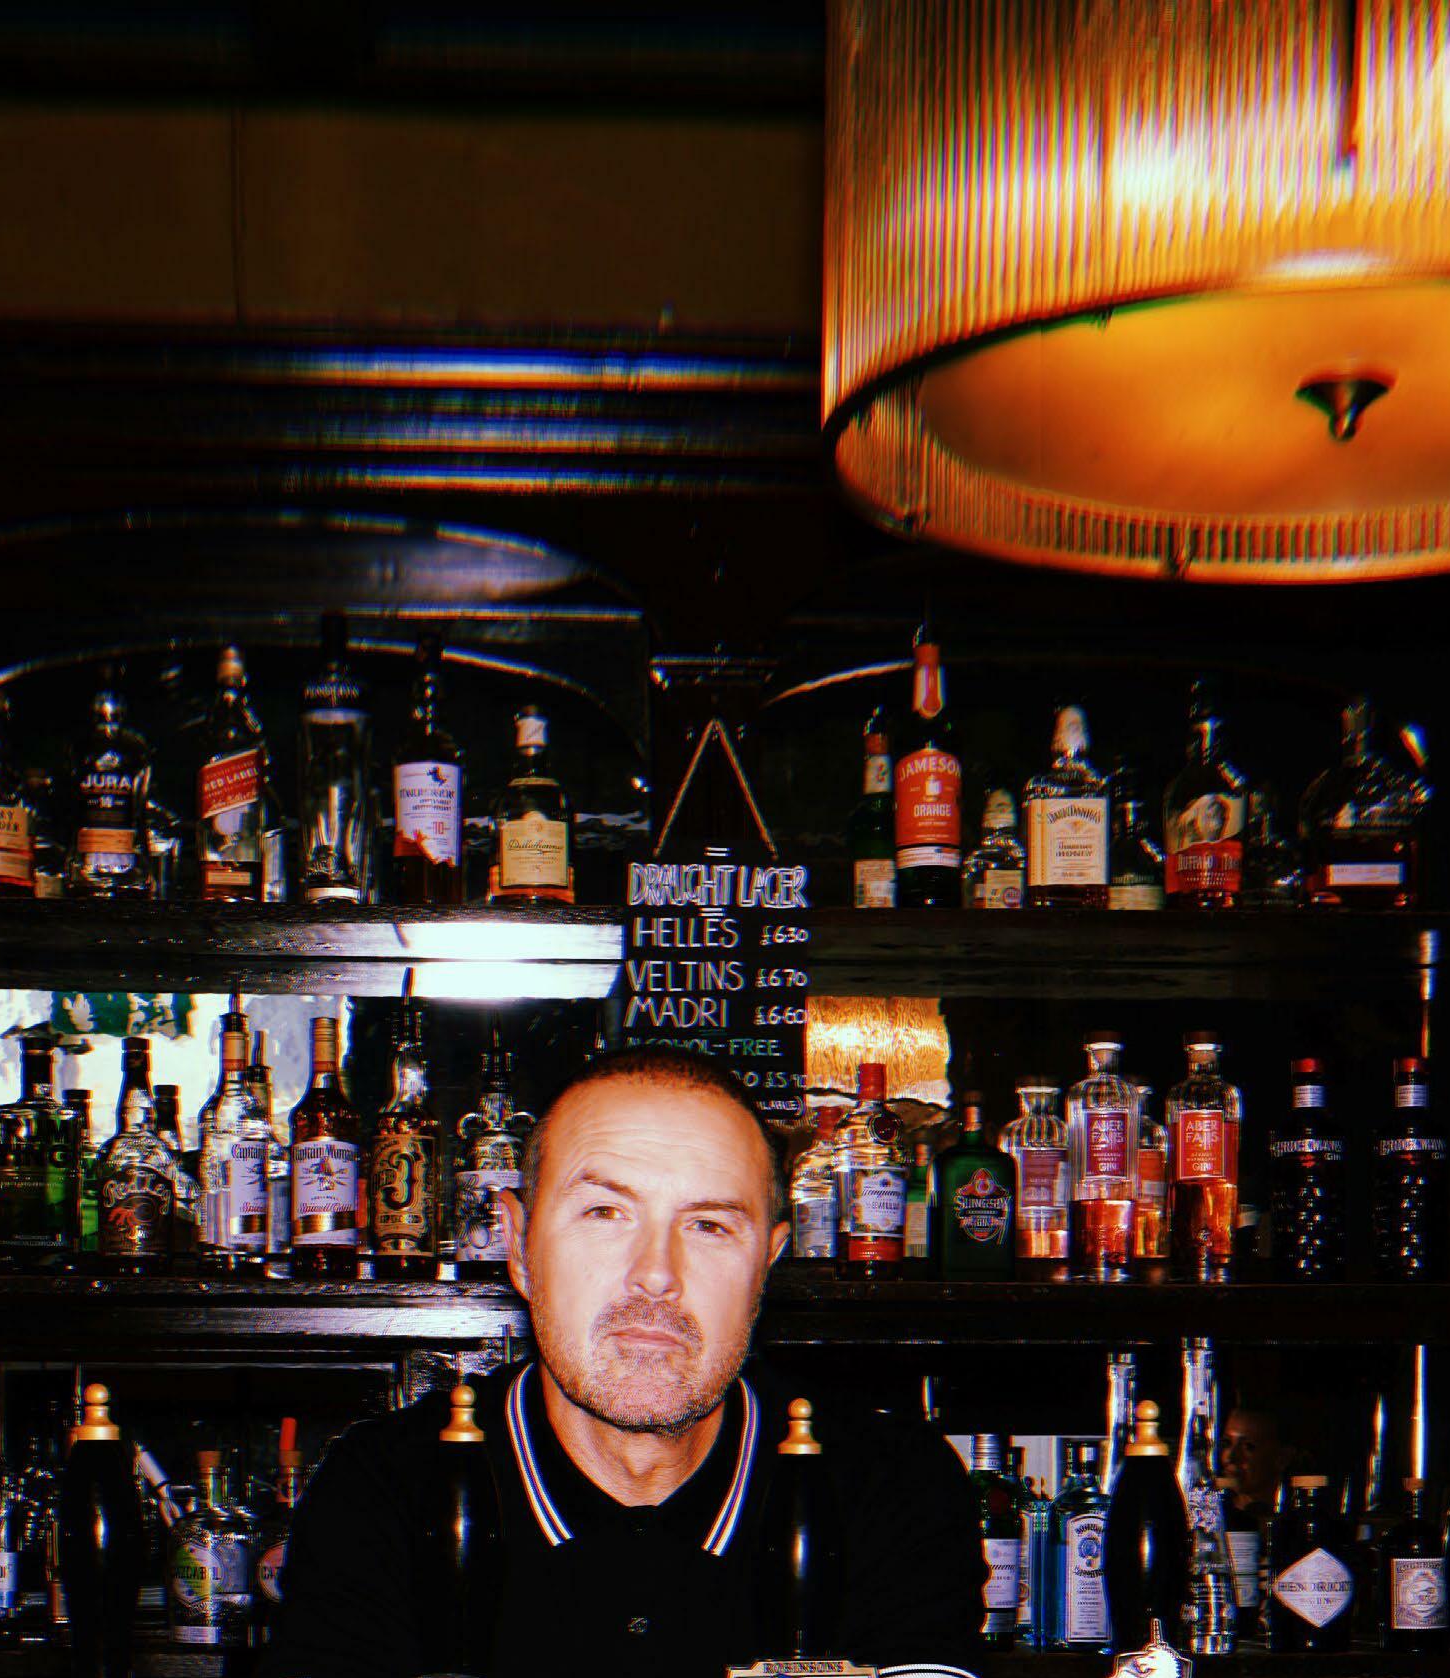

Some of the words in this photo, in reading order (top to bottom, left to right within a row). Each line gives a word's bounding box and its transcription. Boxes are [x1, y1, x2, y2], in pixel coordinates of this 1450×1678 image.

[80, 772, 133, 789] JURA
[899, 754, 963, 782] JAMESON
[913, 803, 952, 818] ORANGE
[626, 861, 738, 907] DRAUGHT
[735, 863, 812, 909] LAGER
[632, 916, 740, 948] HELLES
[625, 959, 747, 992] VELTINS
[623, 995, 730, 1028] MADRI
[1090, 1118, 1124, 1133] ABER
[1185, 1118, 1218, 1132] ABER
